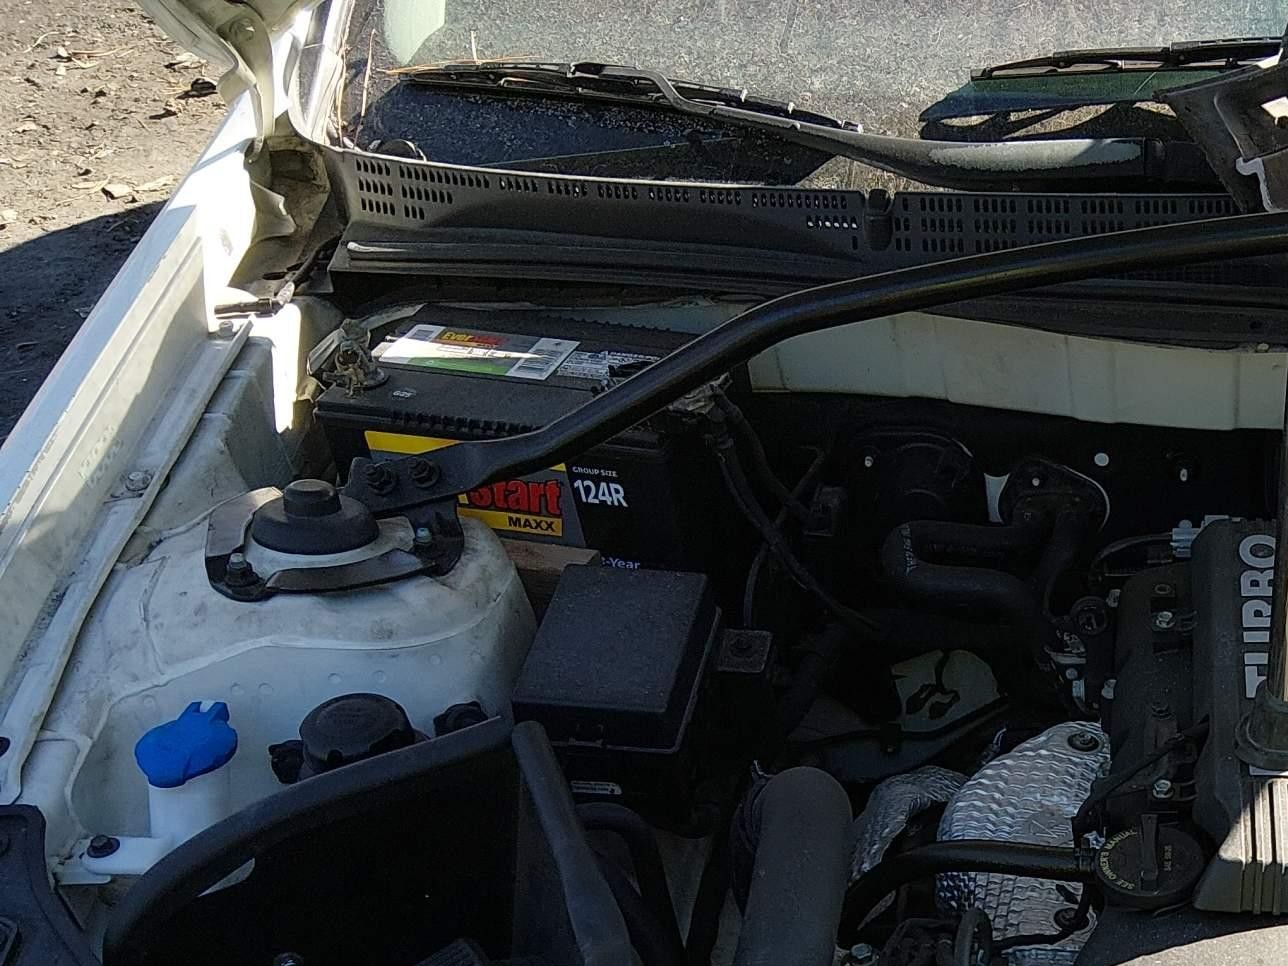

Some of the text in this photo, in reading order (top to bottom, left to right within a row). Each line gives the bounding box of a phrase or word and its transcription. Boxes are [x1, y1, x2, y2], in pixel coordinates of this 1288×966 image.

[571, 466, 619, 478] GROUP SIZE
[573, 479, 629, 508] 124R
[507, 515, 556, 532] MAXX
